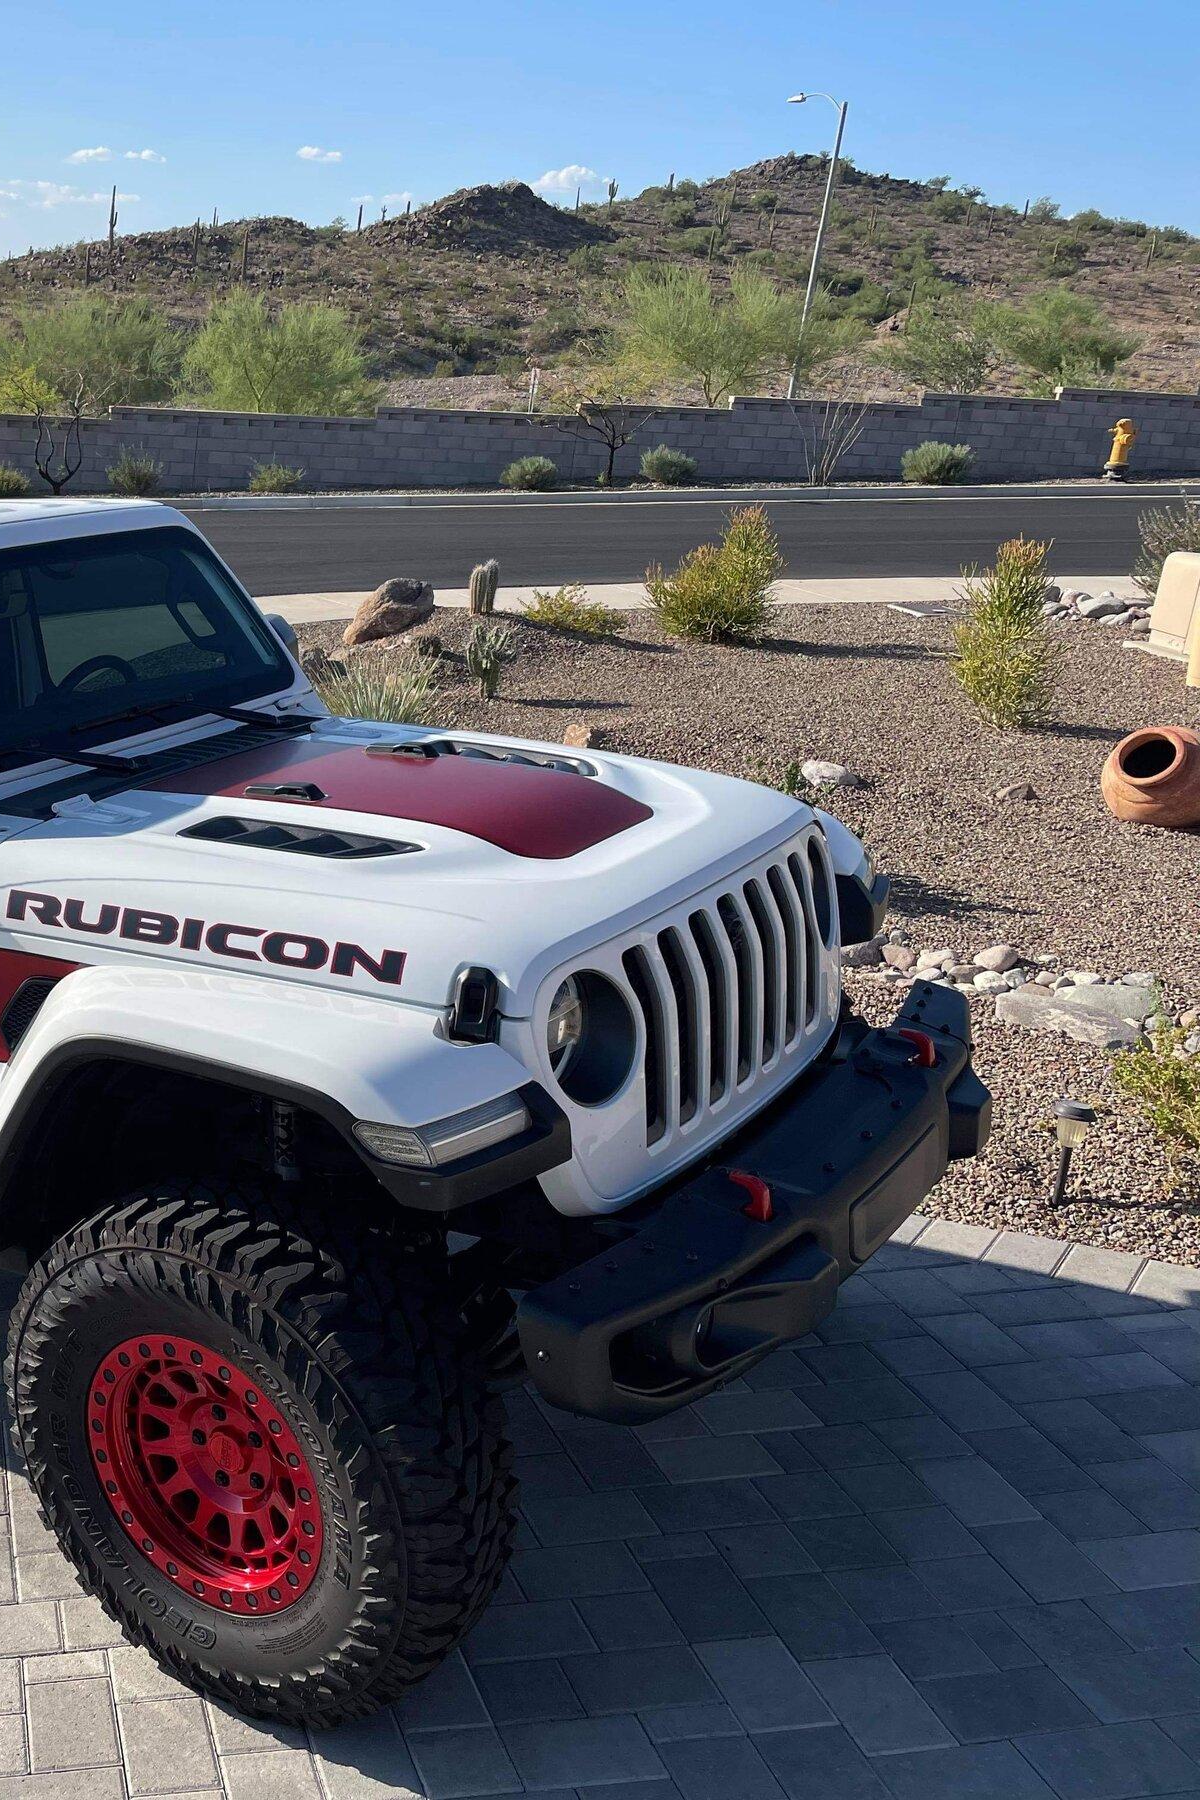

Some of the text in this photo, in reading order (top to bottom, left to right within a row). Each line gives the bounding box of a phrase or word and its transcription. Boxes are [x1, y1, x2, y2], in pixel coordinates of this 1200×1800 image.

[5, 889, 407, 985] RUBICON
[273, 1109, 296, 1165] FOX
[48, 1409, 218, 1651] GEOLANDAR
[230, 1338, 353, 1590] YOKOHAMA
